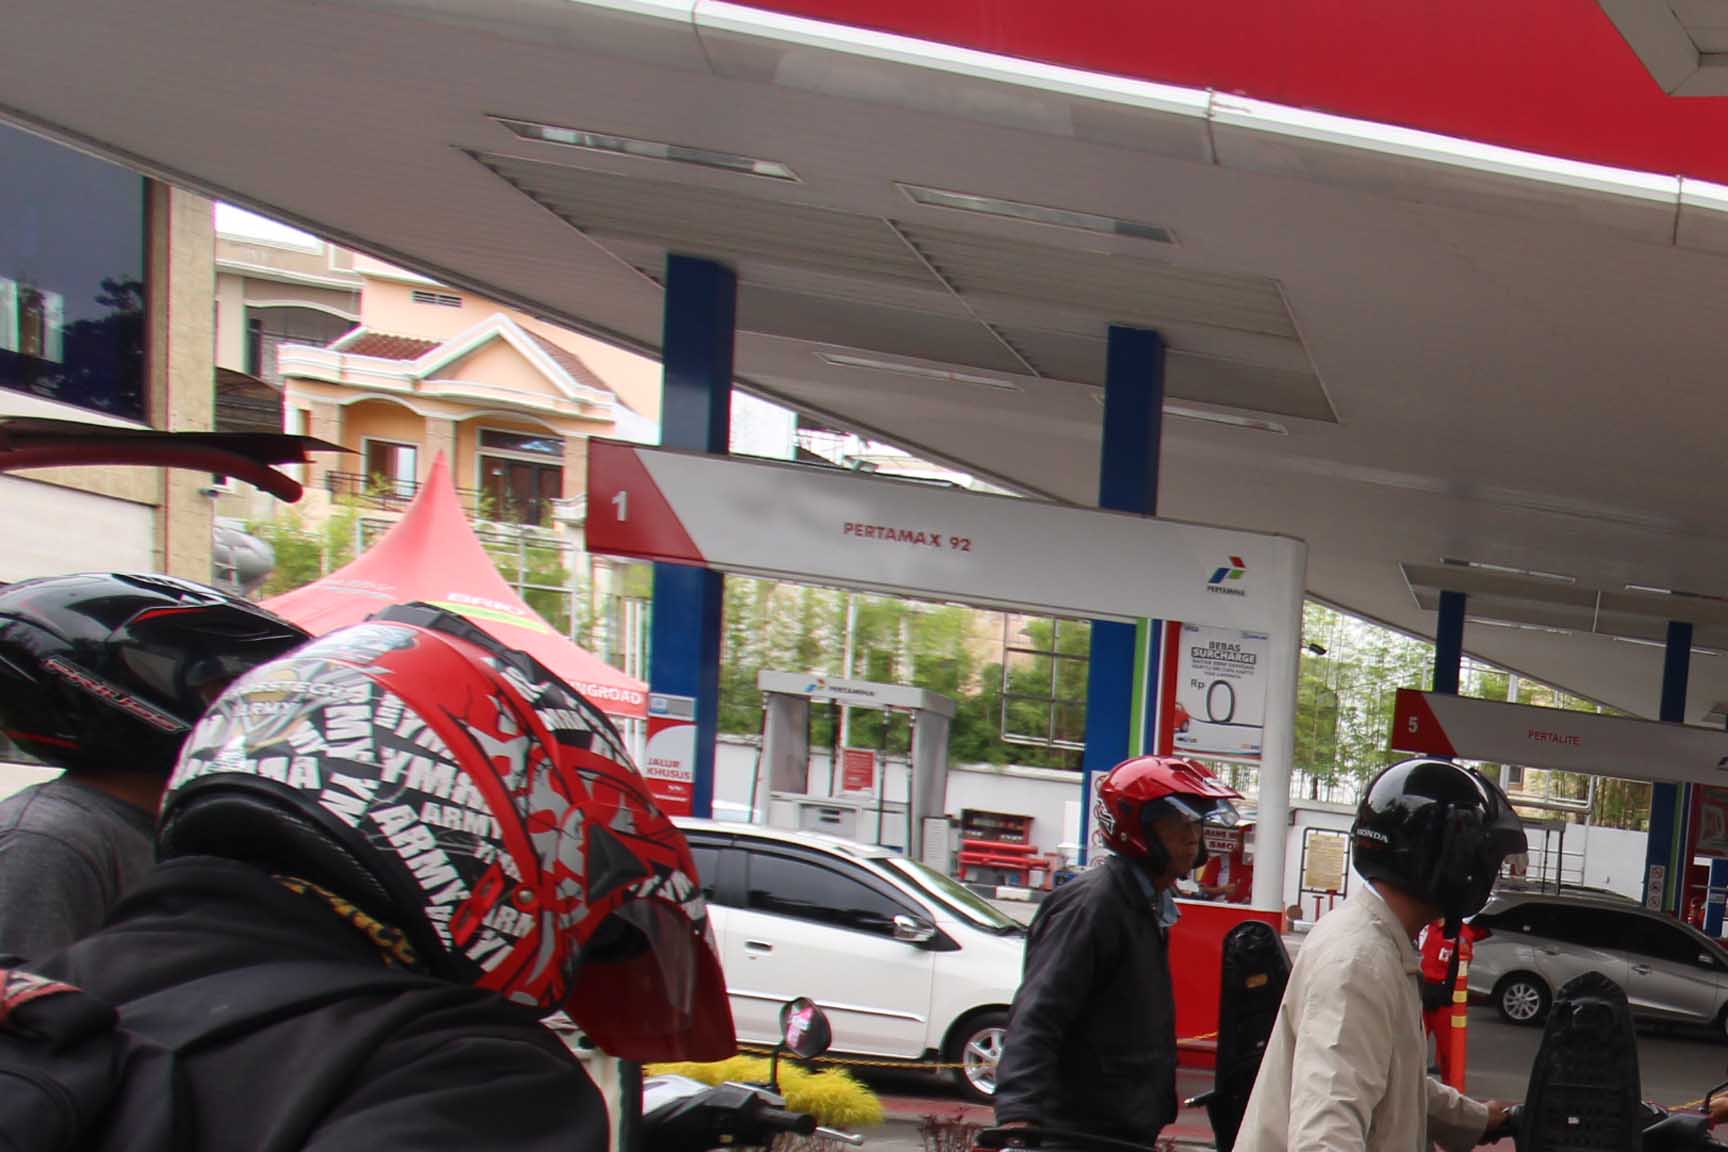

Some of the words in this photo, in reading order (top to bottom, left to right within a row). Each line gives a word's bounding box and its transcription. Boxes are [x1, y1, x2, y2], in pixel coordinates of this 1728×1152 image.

[611, 490, 628, 522] 1
[843, 522, 942, 547] PERTAMAX
[949, 536, 973, 551] 92
[1190, 679, 1205, 690] Rp
[1407, 716, 1419, 733] 5
[1528, 729, 1581, 746] PERTALITE
[1357, 828, 1389, 844] HONDA
[368, 804, 473, 905] ARMY
